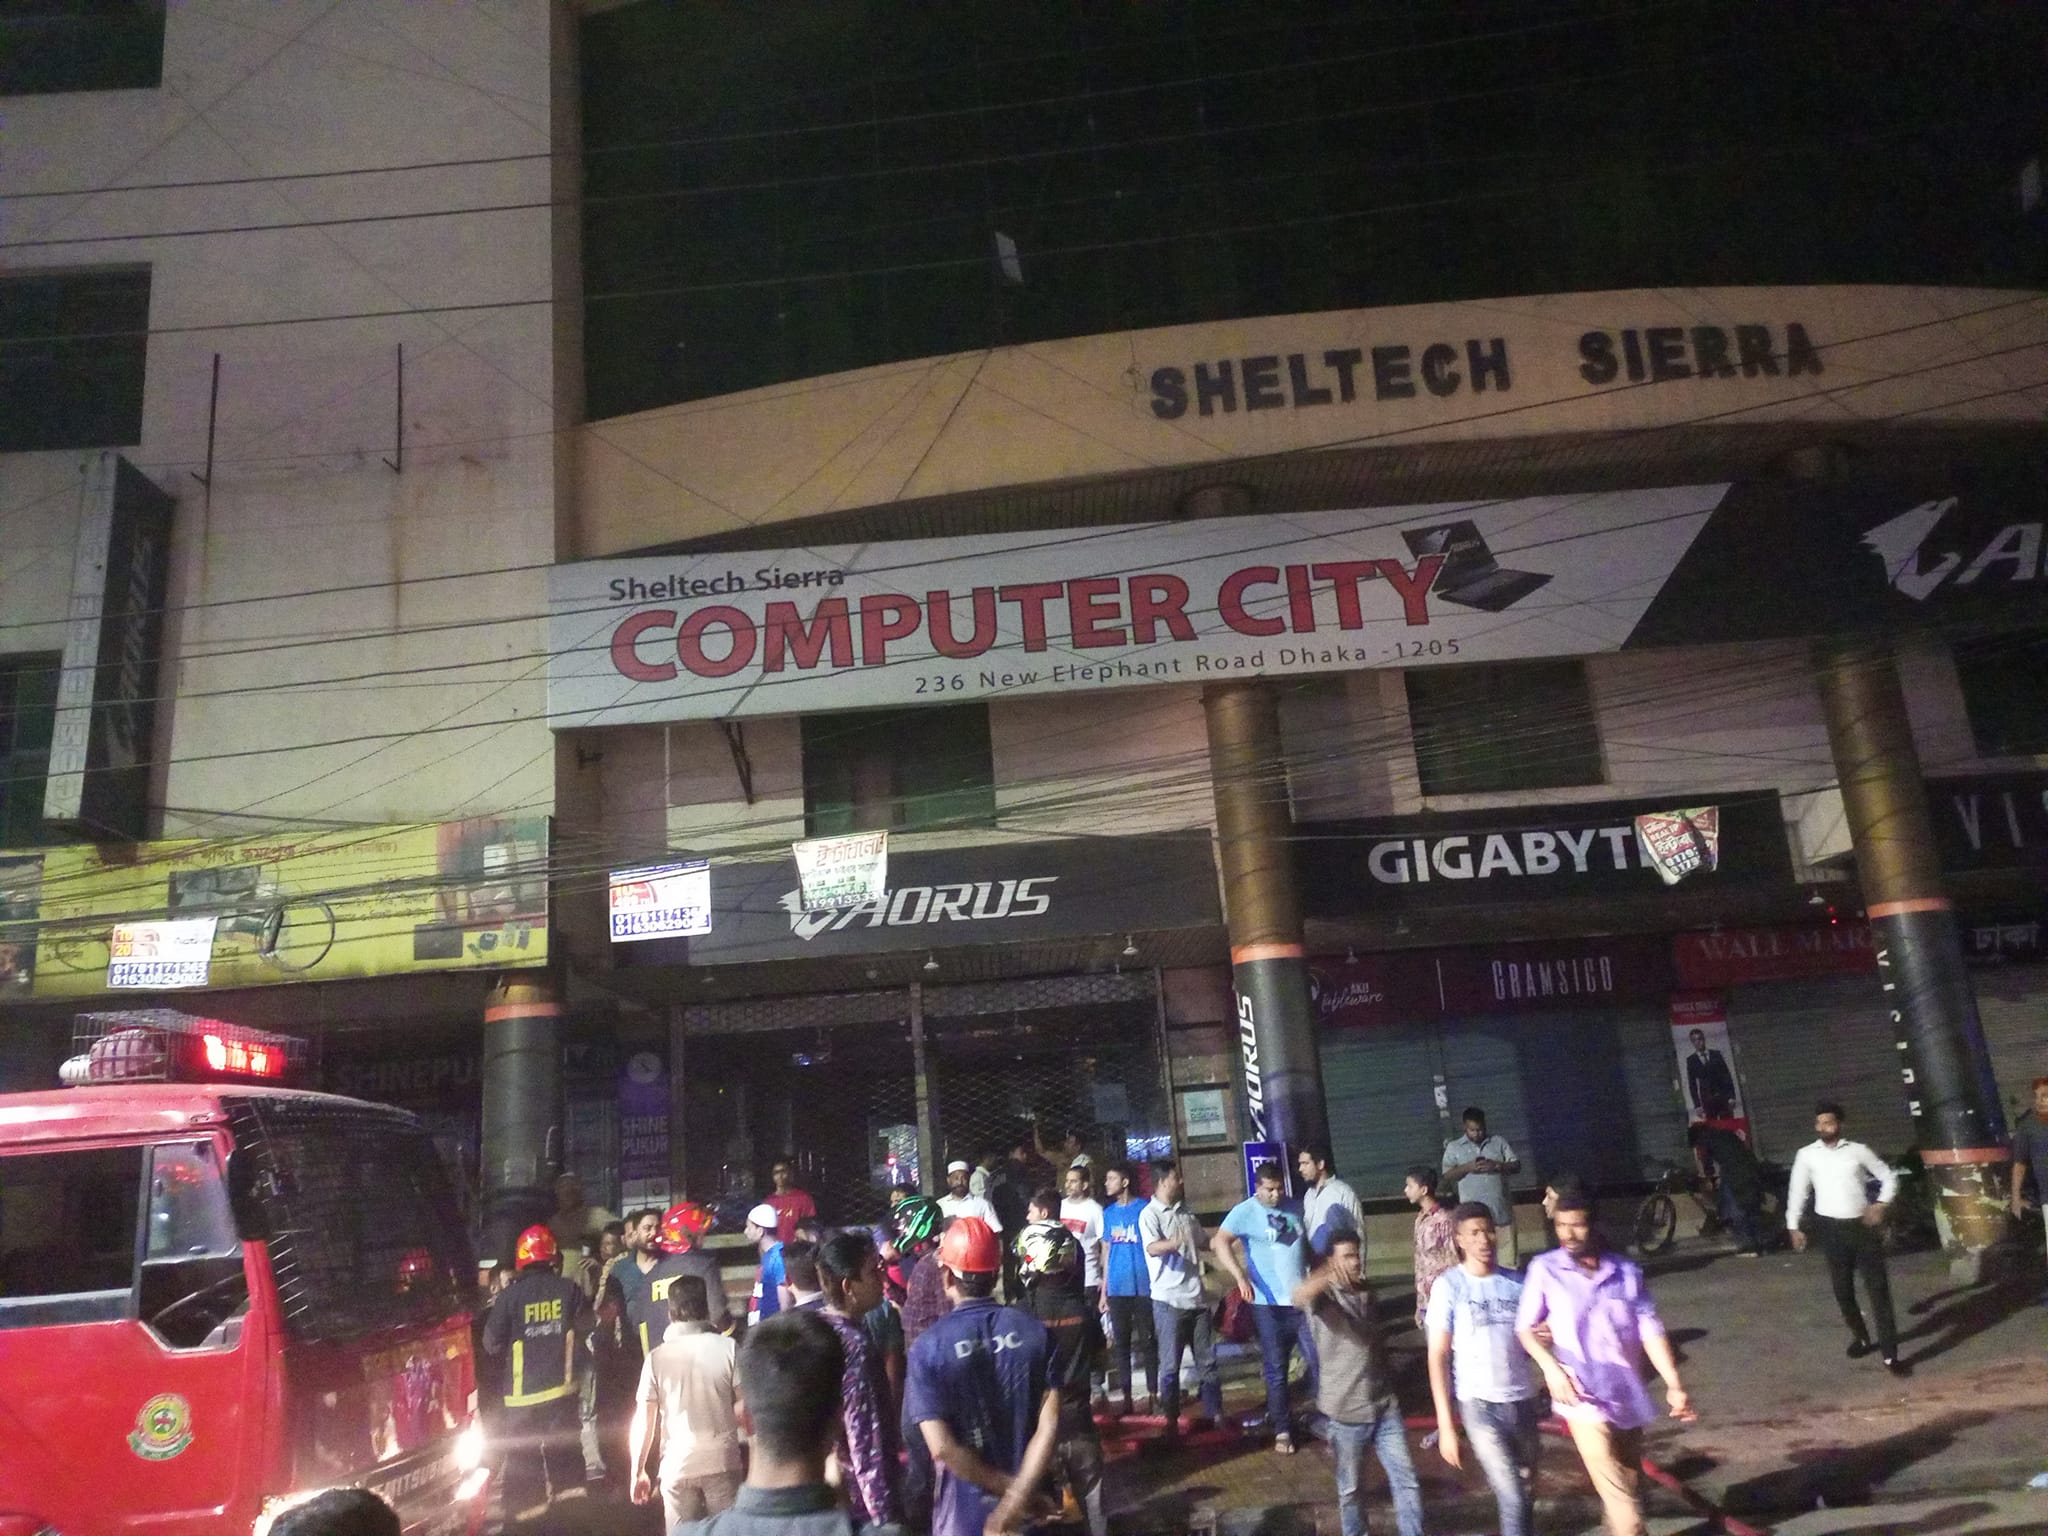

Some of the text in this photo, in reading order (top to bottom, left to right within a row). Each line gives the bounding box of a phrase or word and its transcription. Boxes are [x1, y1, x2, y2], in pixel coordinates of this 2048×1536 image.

[1150, 321, 1826, 420] SHELTECH SIERRA
[1954, 522, 2048, 585] A
[608, 566, 846, 601] Sheltech Sierra
[610, 552, 1447, 683] COMPUTER CITY
[914, 672, 966, 695] 236
[979, 667, 1038, 689] New
[1053, 656, 1183, 684] Elephant
[1196, 649, 1266, 673] Road
[1280, 643, 1368, 667] Dhaka
[831, 875, 1059, 930] AORUS
[1799, 927, 1874, 953] MAR
[1238, 994, 1267, 1139] AORUS
[524, 1297, 562, 1325] FIRE
